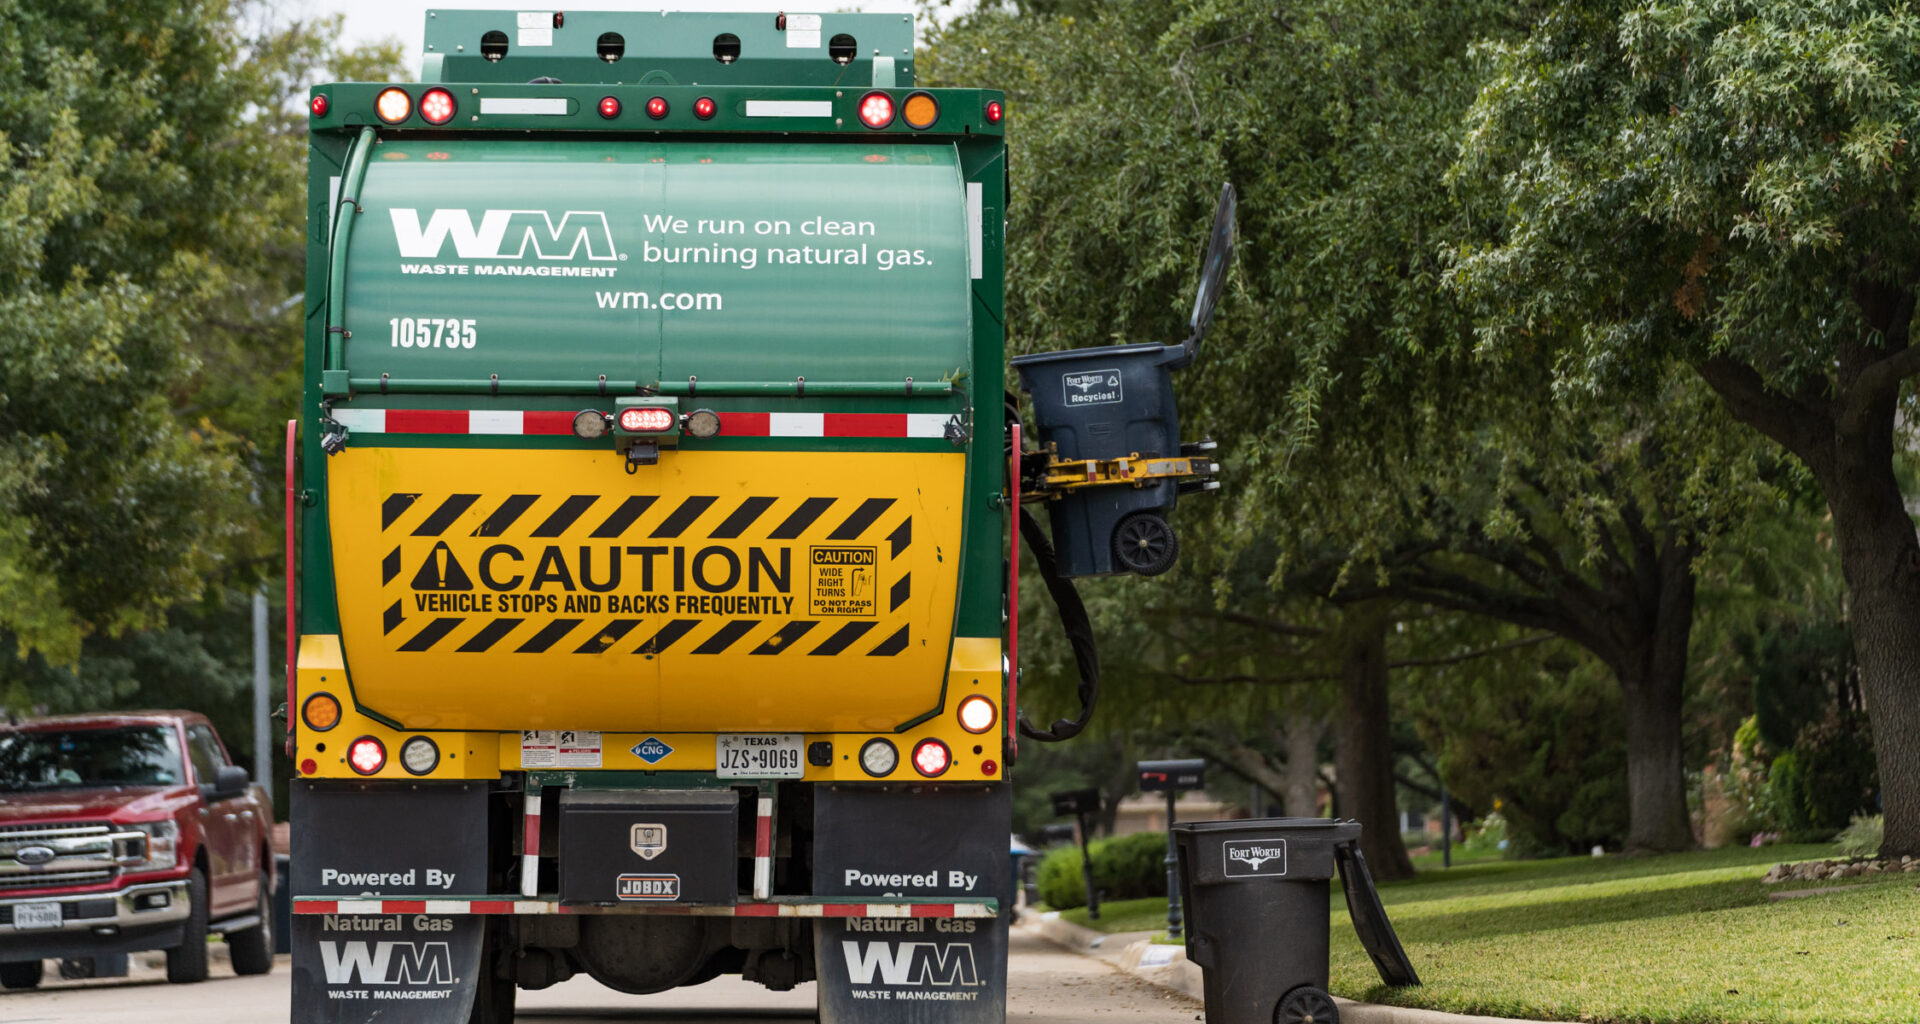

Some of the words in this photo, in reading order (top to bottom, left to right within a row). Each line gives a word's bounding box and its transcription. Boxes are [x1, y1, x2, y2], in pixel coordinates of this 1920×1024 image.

[643, 214, 689, 234] We
[697, 218, 745, 235] run
[753, 219, 791, 236] on
[800, 216, 876, 236] clean
[388, 208, 618, 261] WM
[643, 241, 757, 270] burning
[767, 244, 868, 265] natural
[876, 248, 933, 271] gas.
[400, 264, 469, 276] WASTE
[474, 265, 618, 278] MANAGEMENT
[595, 290, 723, 311] wm.com
[389, 317, 477, 349] 105735
[814, 551, 873, 564] CAUTION
[478, 543, 792, 594] CAUTION
[819, 567, 844, 577] WIDE
[818, 578, 845, 587] RIGHT
[816, 588, 846, 597] TURNS
[415, 593, 492, 613] VEHICLE
[498, 594, 558, 614] STOPS
[564, 594, 602, 613] AND
[608, 594, 669, 614] BACKS
[675, 595, 795, 616] FREQUENTLY
[813, 599, 827, 607] DO
[829, 599, 847, 607] NOT
[744, 737, 778, 746] TEXAS
[641, 745, 664, 755] CNG
[1229, 847, 1250, 858] FORT
[1250, 846, 1281, 857] WORTH
[321, 868, 416, 886] Powered
[425, 868, 456, 889] By
[845, 869, 938, 887] Powered
[948, 870, 978, 891] By
[622, 880, 674, 895] JOBOX
[323, 914, 402, 931] Natural
[412, 915, 454, 932] Gas
[845, 917, 925, 932] Natural
[935, 917, 977, 933] Gas
[319, 940, 453, 985] WM
[842, 940, 979, 986] WM
[328, 989, 369, 1000] WASTE
[373, 989, 453, 1000] MANAGEMENT
[851, 990, 891, 1000] WASTE
[895, 990, 979, 1001] MANAGEMENT
